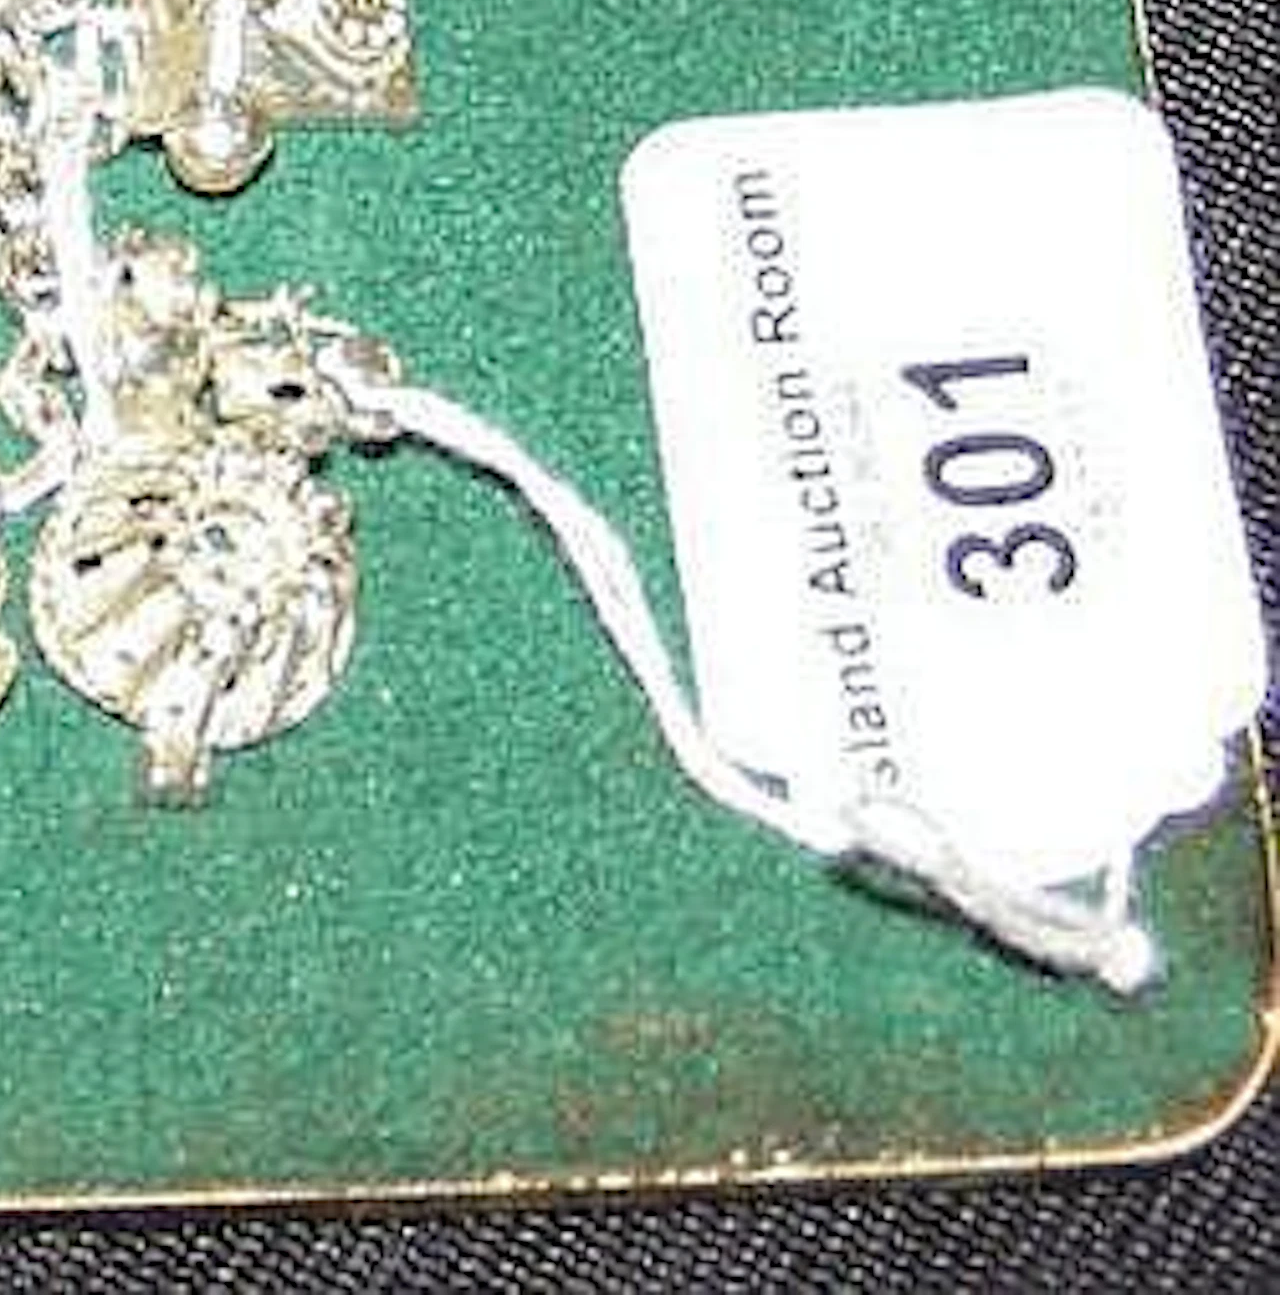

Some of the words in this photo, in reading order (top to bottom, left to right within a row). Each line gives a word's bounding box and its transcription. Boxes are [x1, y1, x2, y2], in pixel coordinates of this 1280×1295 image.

[734, 169, 800, 345] Room
[774, 367, 856, 598] Auction
[899, 353, 1078, 599] 301
[816, 621, 902, 789] sland
